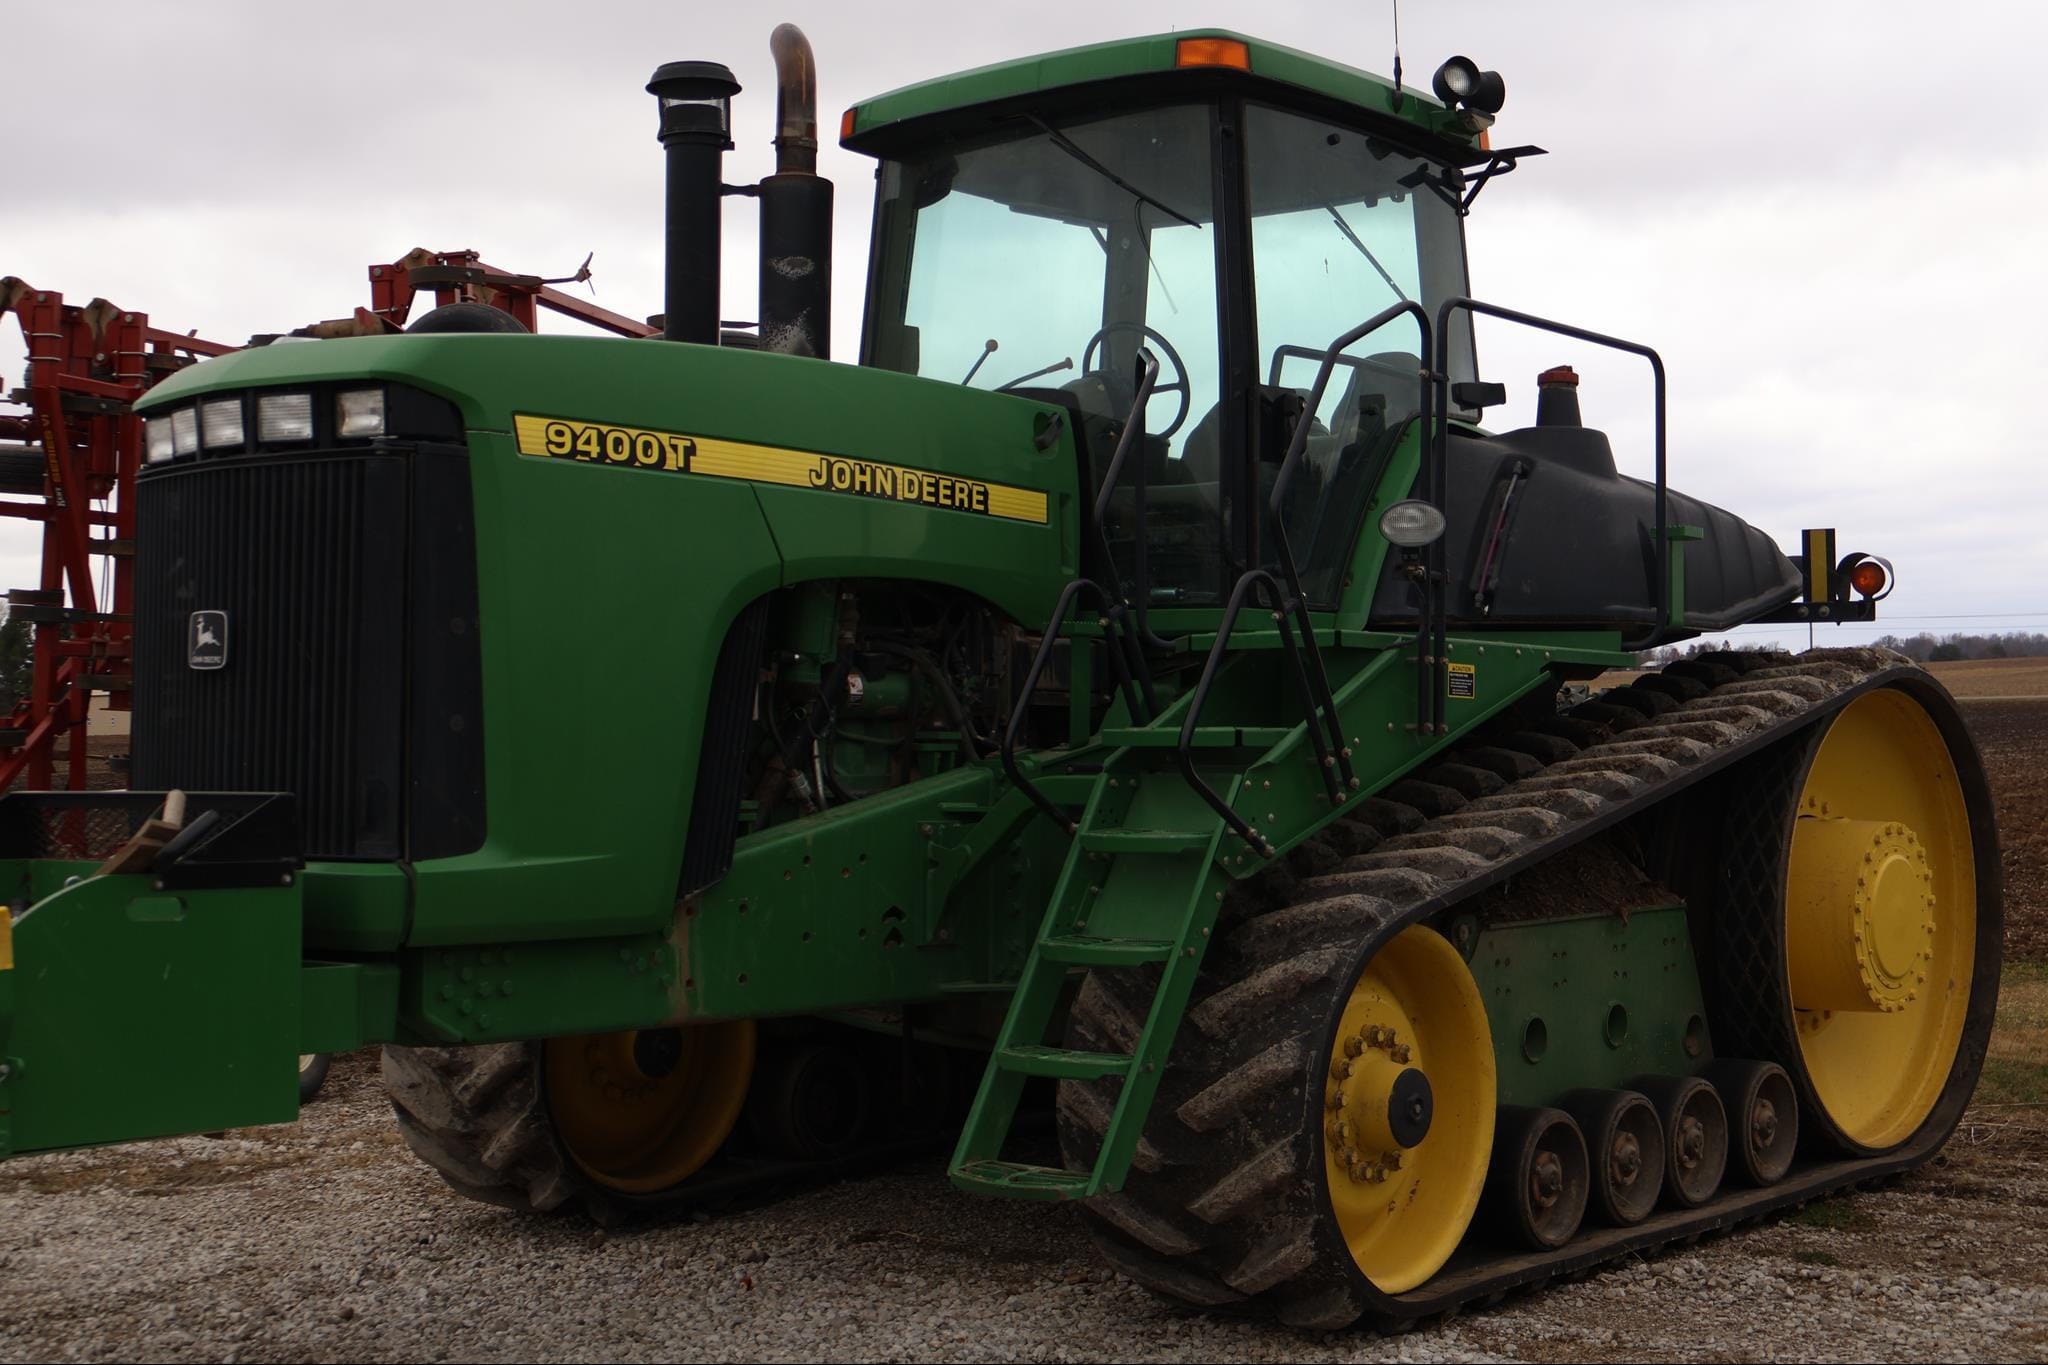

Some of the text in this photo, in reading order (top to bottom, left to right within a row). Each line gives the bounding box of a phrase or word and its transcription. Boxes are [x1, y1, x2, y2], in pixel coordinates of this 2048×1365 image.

[545, 422, 697, 472] 9400T
[809, 457, 989, 514] JOHN DEERE
